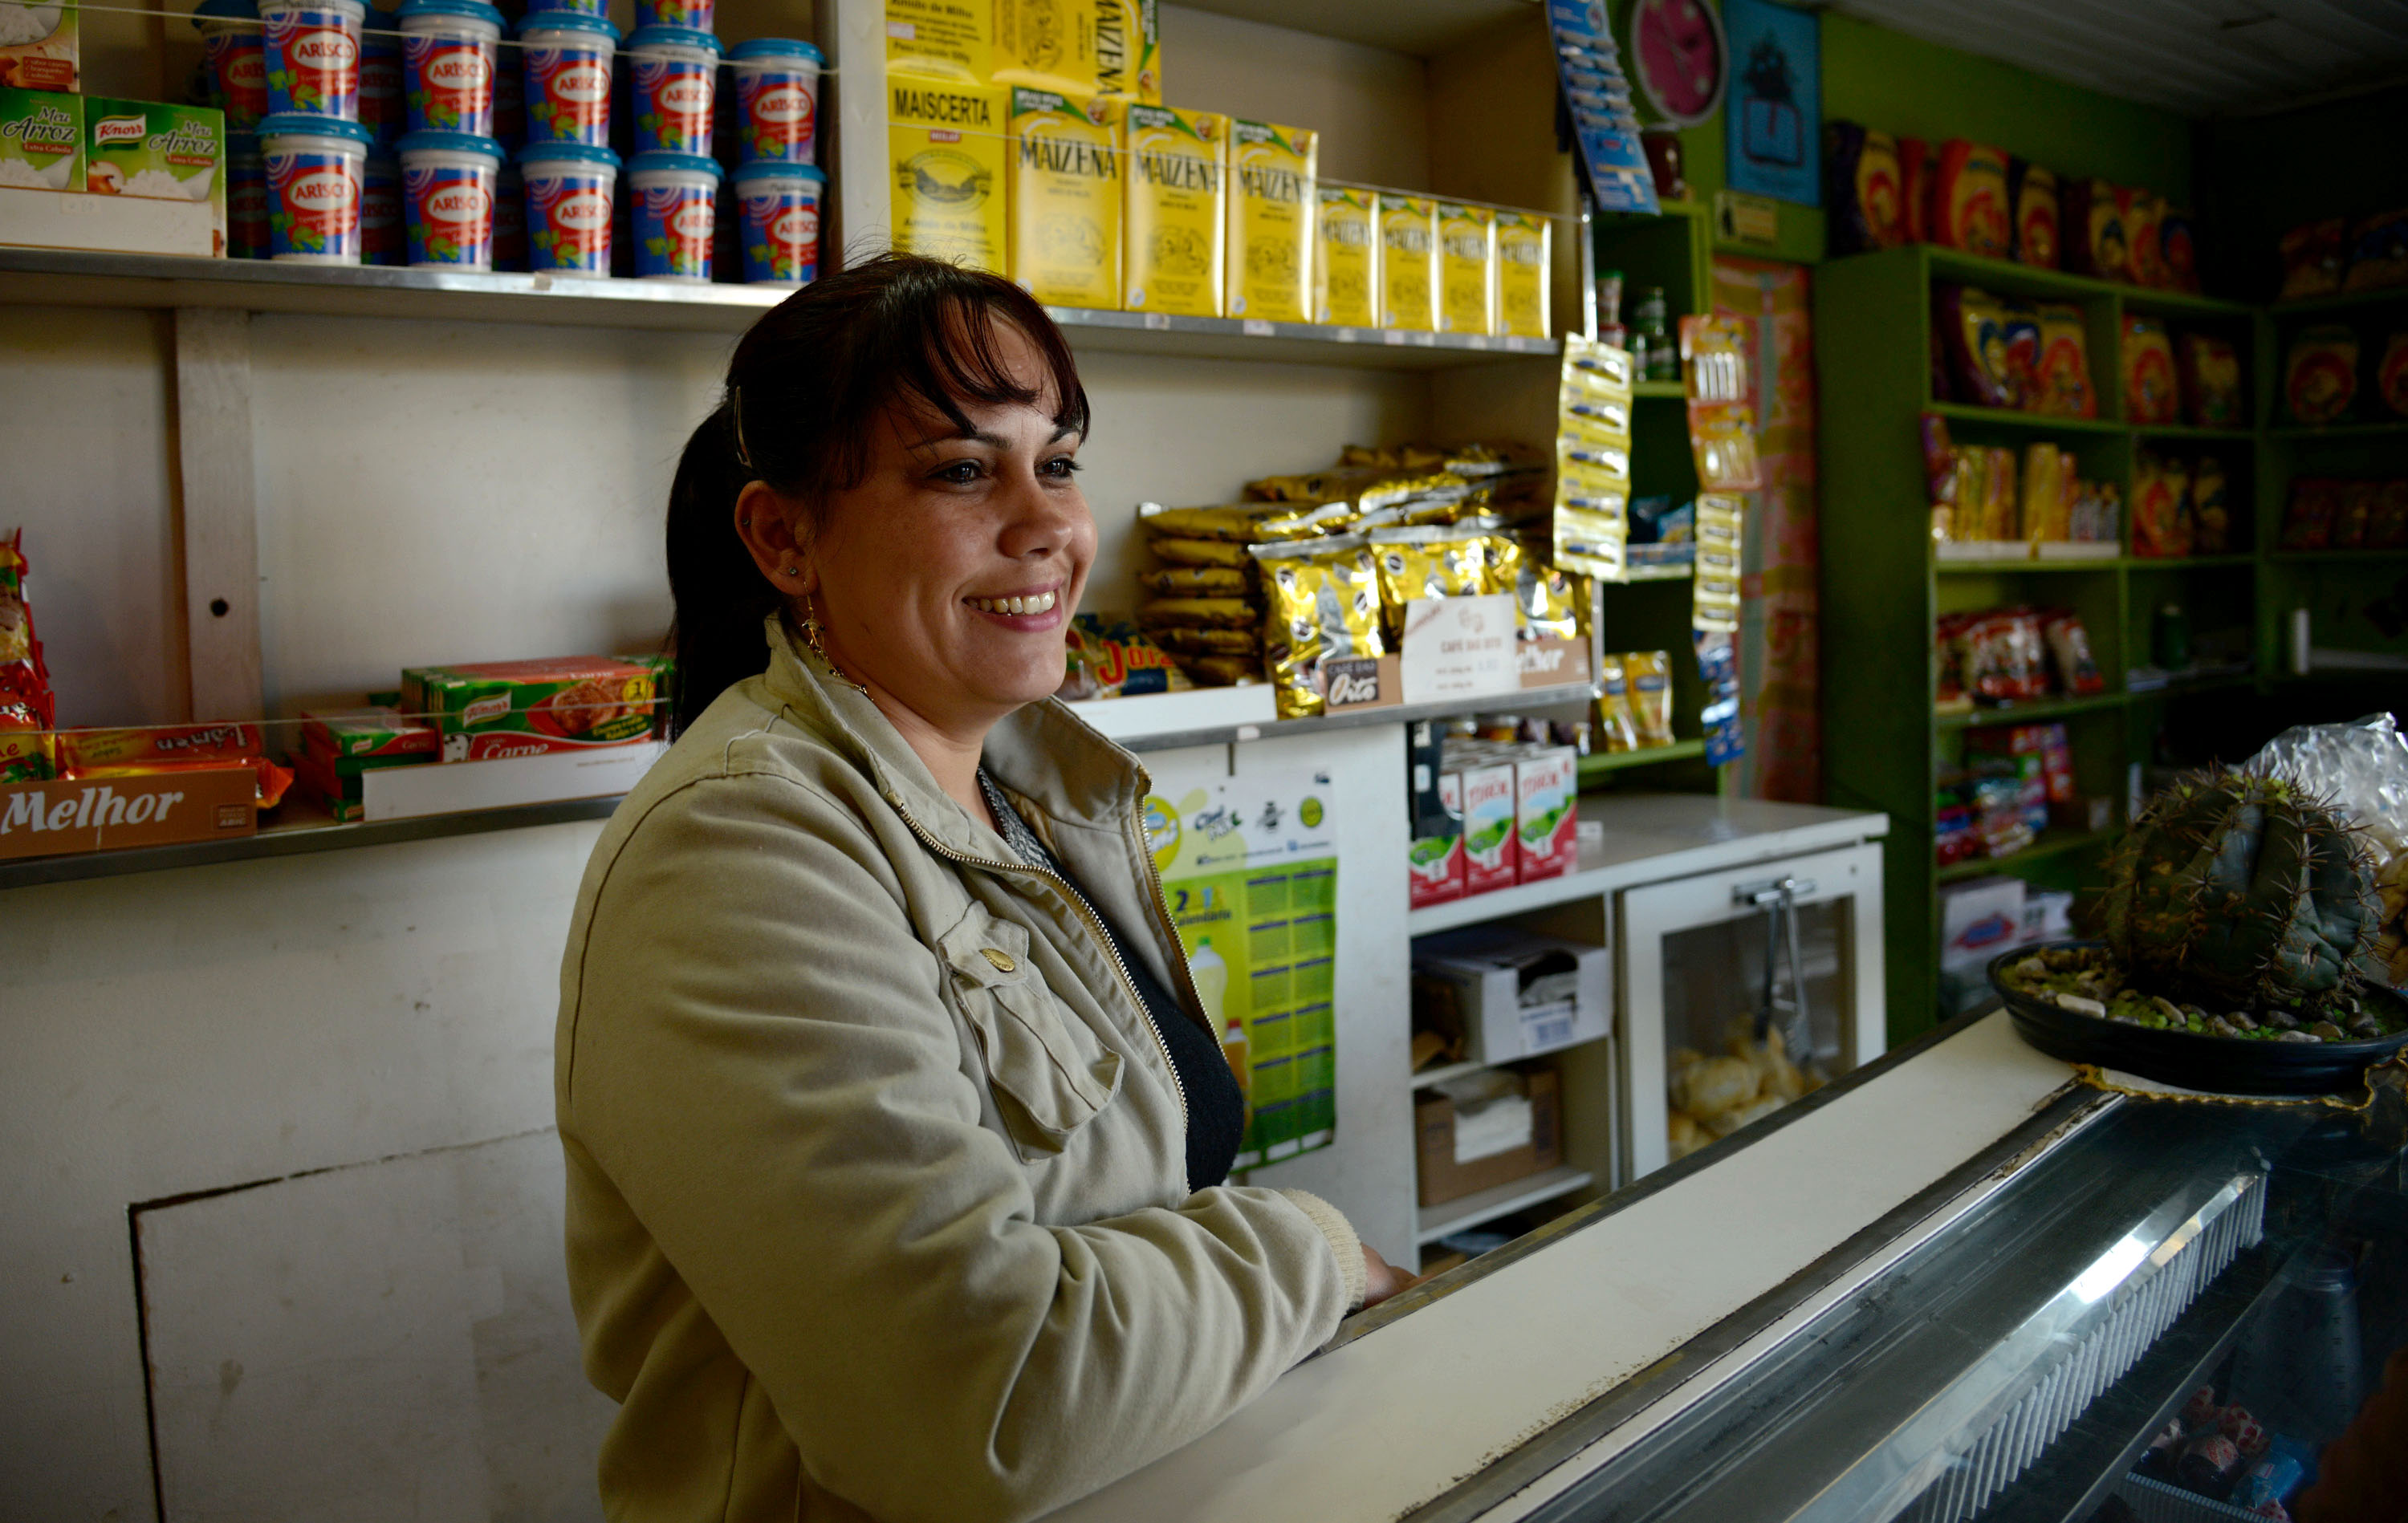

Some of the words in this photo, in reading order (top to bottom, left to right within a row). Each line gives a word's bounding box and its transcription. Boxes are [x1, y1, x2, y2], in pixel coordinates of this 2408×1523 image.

[298, 41, 354, 59] ARISCO
[432, 62, 484, 79] ARISCO
[558, 75, 608, 91] ARISCO
[665, 87, 711, 103] ARISCO
[760, 97, 811, 113] ARISCO
[894, 88, 991, 127] MAISCERTA
[38, 106, 71, 123] Meu
[3, 116, 76, 142] Arroz
[96, 124, 143, 139] Knorr
[149, 130, 217, 154] Arroz
[1019, 133, 1117, 180] MAIZENA
[295, 183, 352, 200] ARISCO
[432, 197, 486, 212] ARISCO
[560, 205, 610, 220] ARISCO
[1328, 672, 1378, 706] Oito
[482, 742, 550, 759] Carne
[0, 786, 185, 835] Melhor
